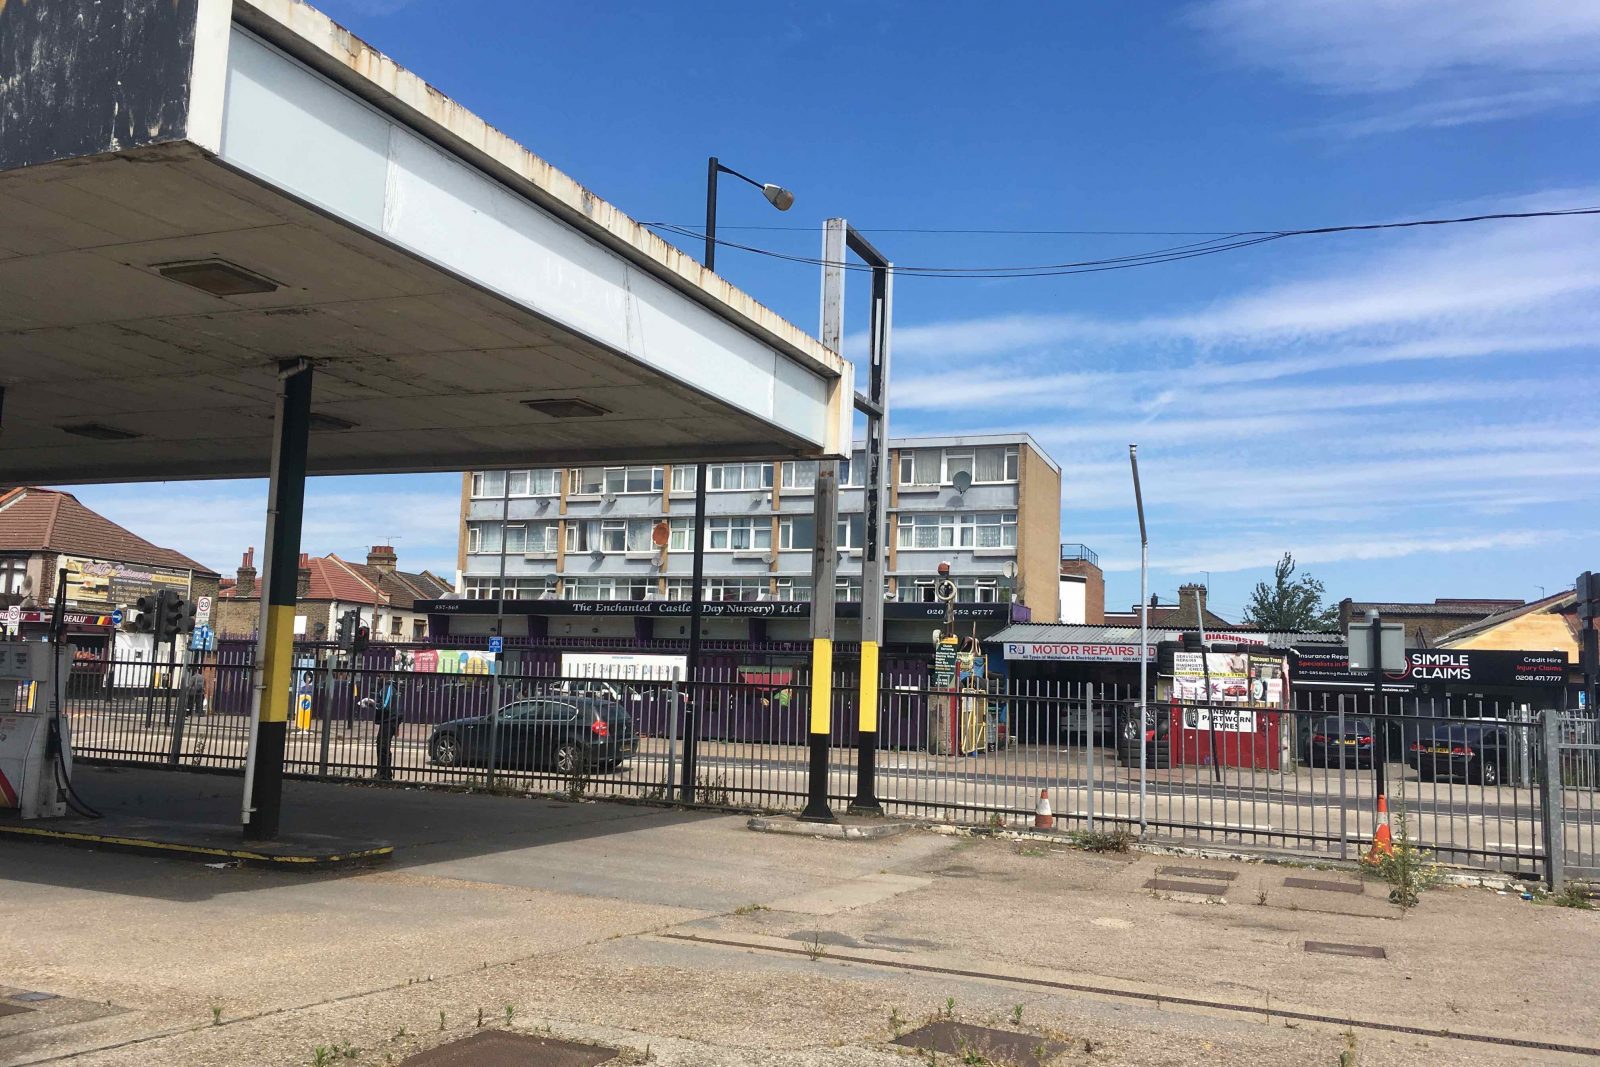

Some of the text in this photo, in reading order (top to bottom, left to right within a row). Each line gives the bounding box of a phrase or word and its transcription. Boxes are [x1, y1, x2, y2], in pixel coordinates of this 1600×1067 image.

[572, 603, 592, 612] The
[595, 603, 651, 613] Enchanted
[658, 603, 692, 613] Castle
[726, 604, 775, 616] Nursery)
[780, 604, 801, 614] Ltd
[971, 608, 994, 616] 6777
[1032, 645, 1079, 655] MOTOR
[1082, 645, 1134, 656] REPAIRS
[1137, 647, 1156, 657] LD
[1412, 653, 1469, 666] SIMPLE
[1412, 667, 1471, 680] CLAIMS
